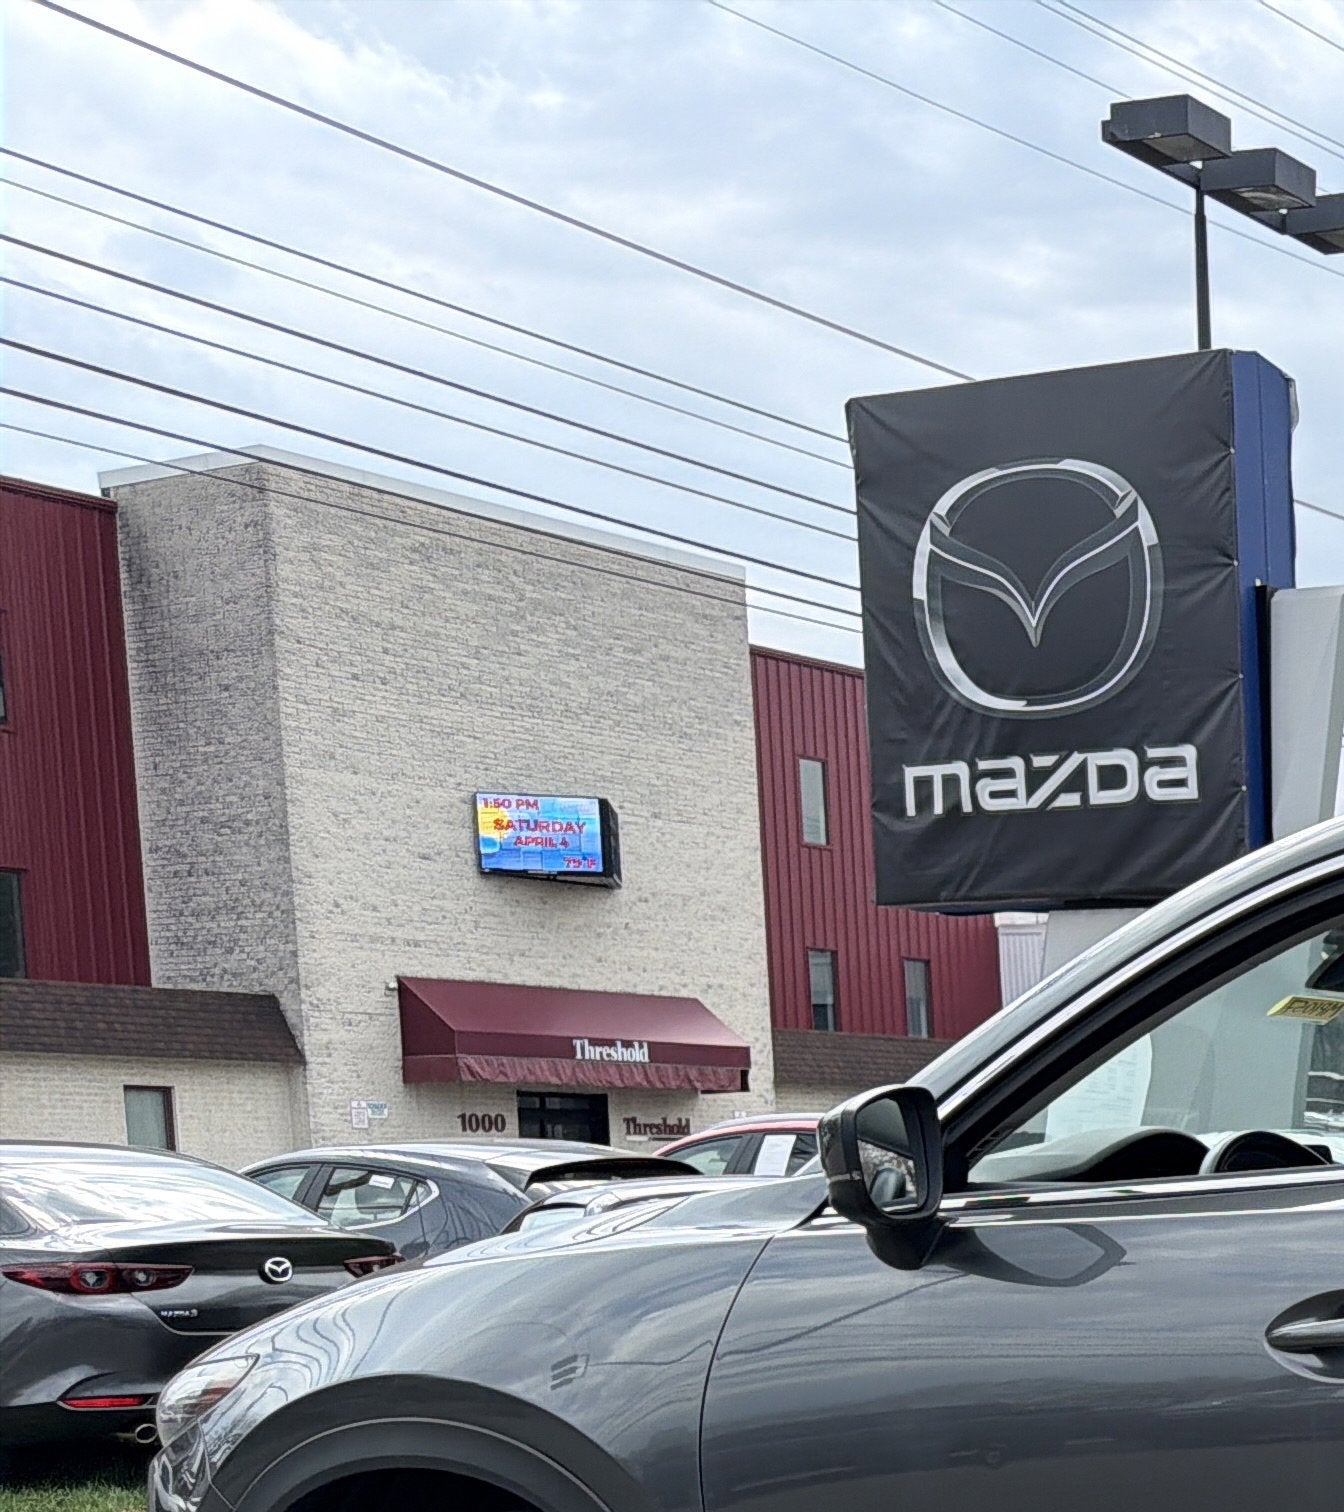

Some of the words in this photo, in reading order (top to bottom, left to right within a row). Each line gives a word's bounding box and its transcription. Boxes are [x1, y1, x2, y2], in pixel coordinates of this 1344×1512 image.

[515, 798, 540, 810] PM
[493, 818, 586, 833] SATURDAY
[514, 836, 557, 848] APRIL
[559, 836, 570, 848] 4
[573, 1038, 650, 1063] Threshold
[457, 1112, 506, 1133] 1000
[623, 1116, 691, 1136] Threshold
